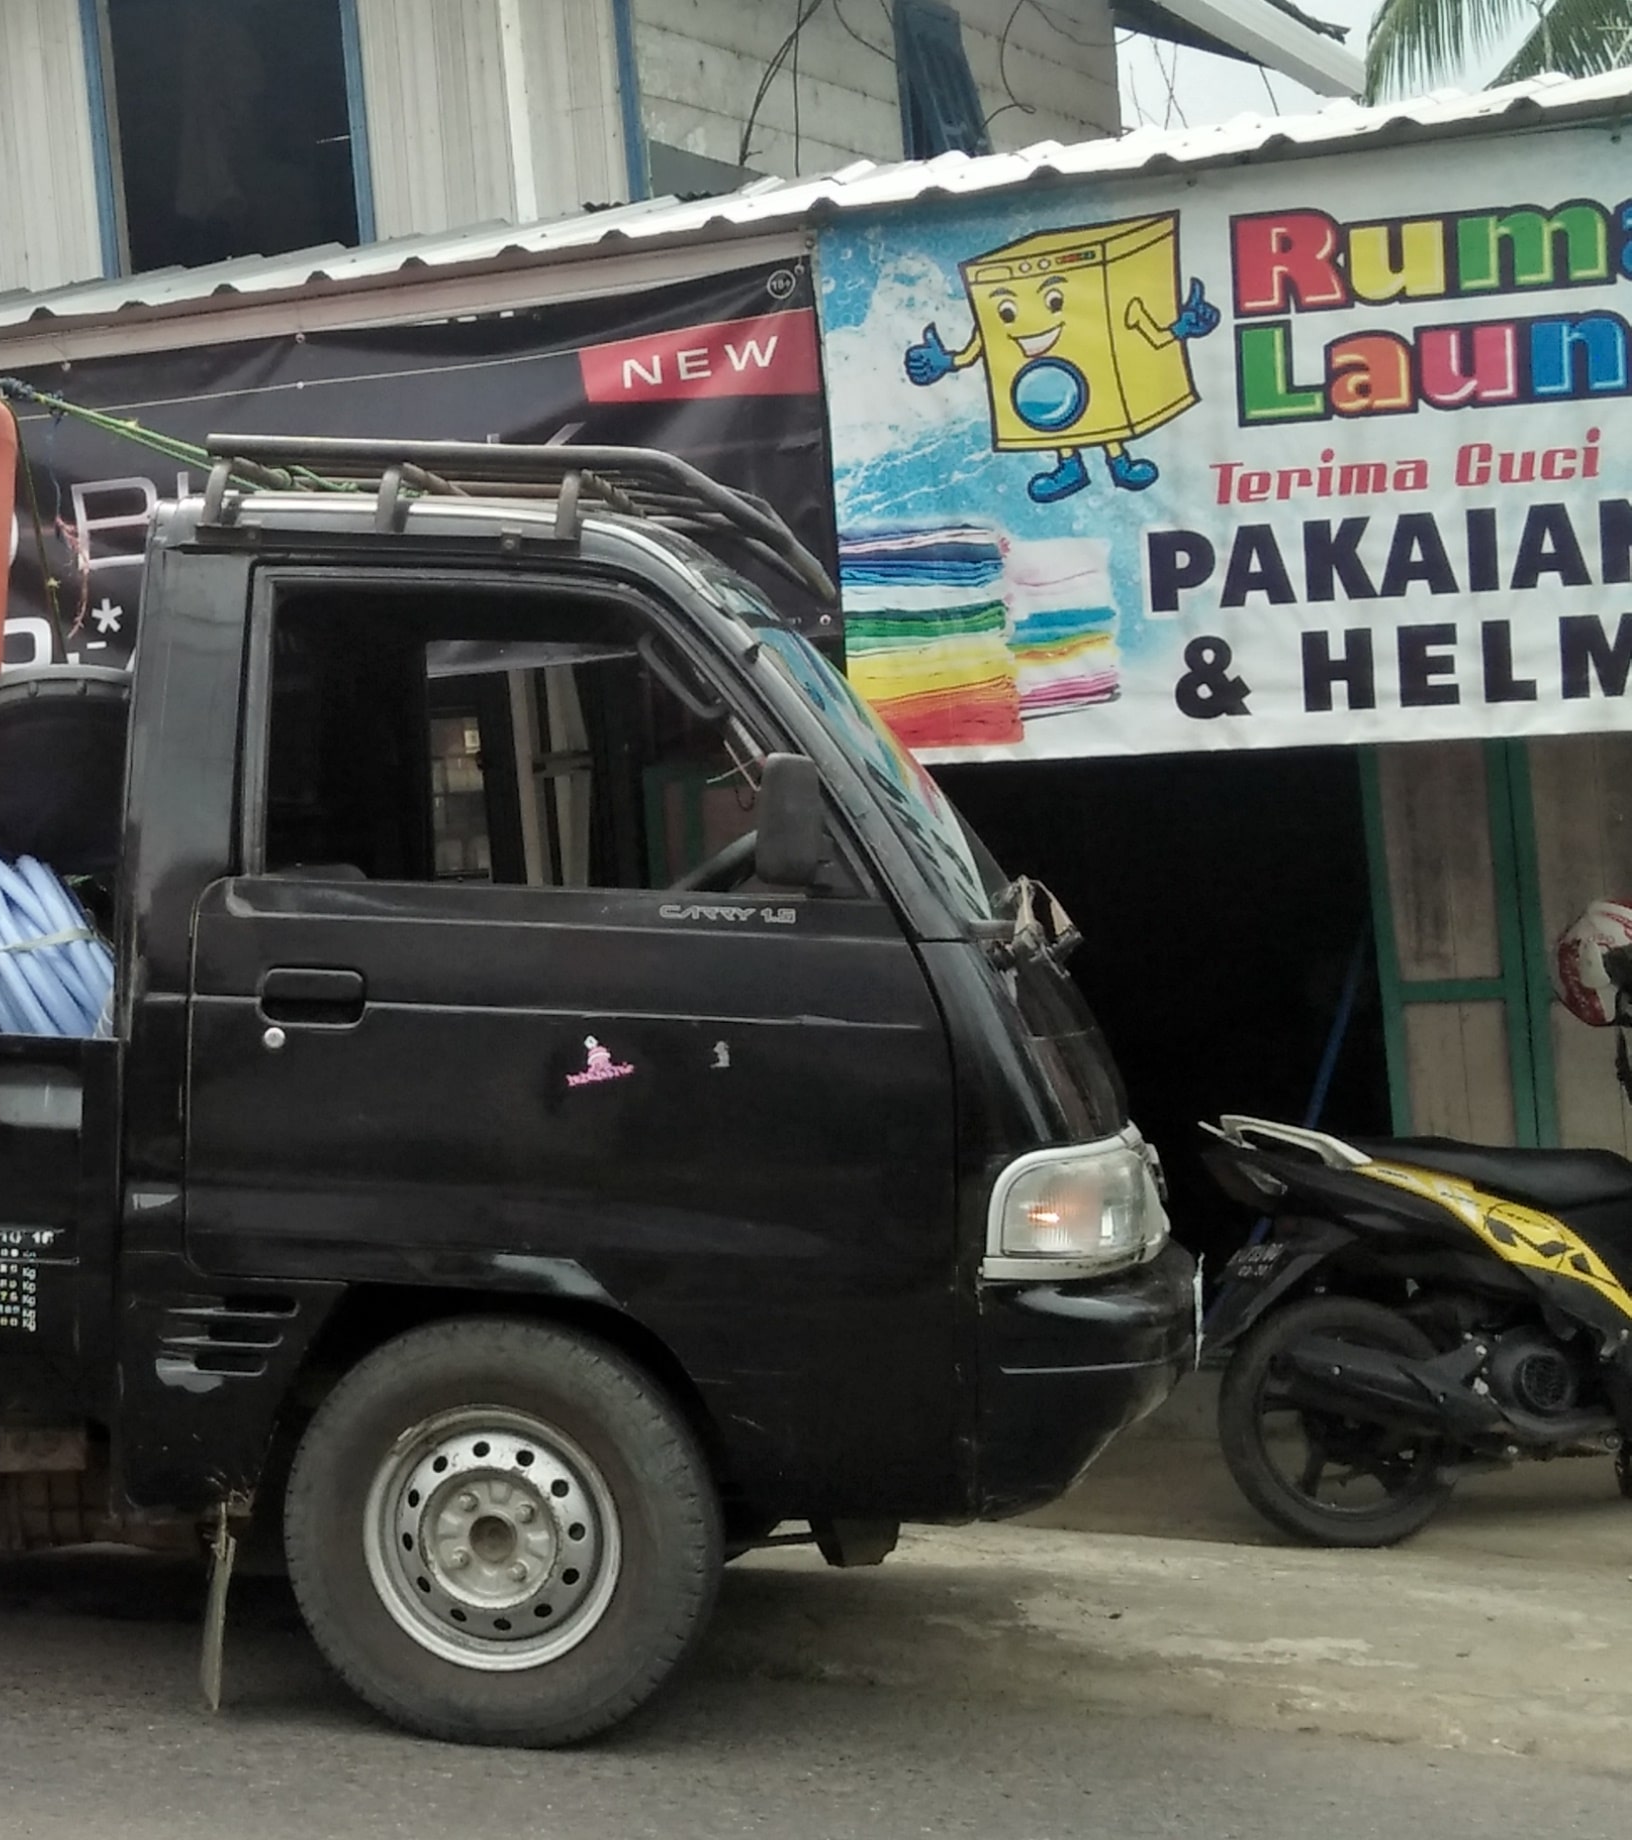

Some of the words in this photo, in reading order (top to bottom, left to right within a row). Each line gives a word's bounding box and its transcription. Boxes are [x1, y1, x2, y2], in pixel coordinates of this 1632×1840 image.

[1230, 198, 1632, 318] Rum
[621, 335, 780, 389] NEW
[1235, 309, 1632, 428] Laun
[1208, 448, 1428, 507] Terima
[1455, 427, 1601, 487] Cuci
[1174, 636, 1252, 719] &
[1301, 612, 1632, 712] HELM
[659, 904, 757, 921] CARRY
